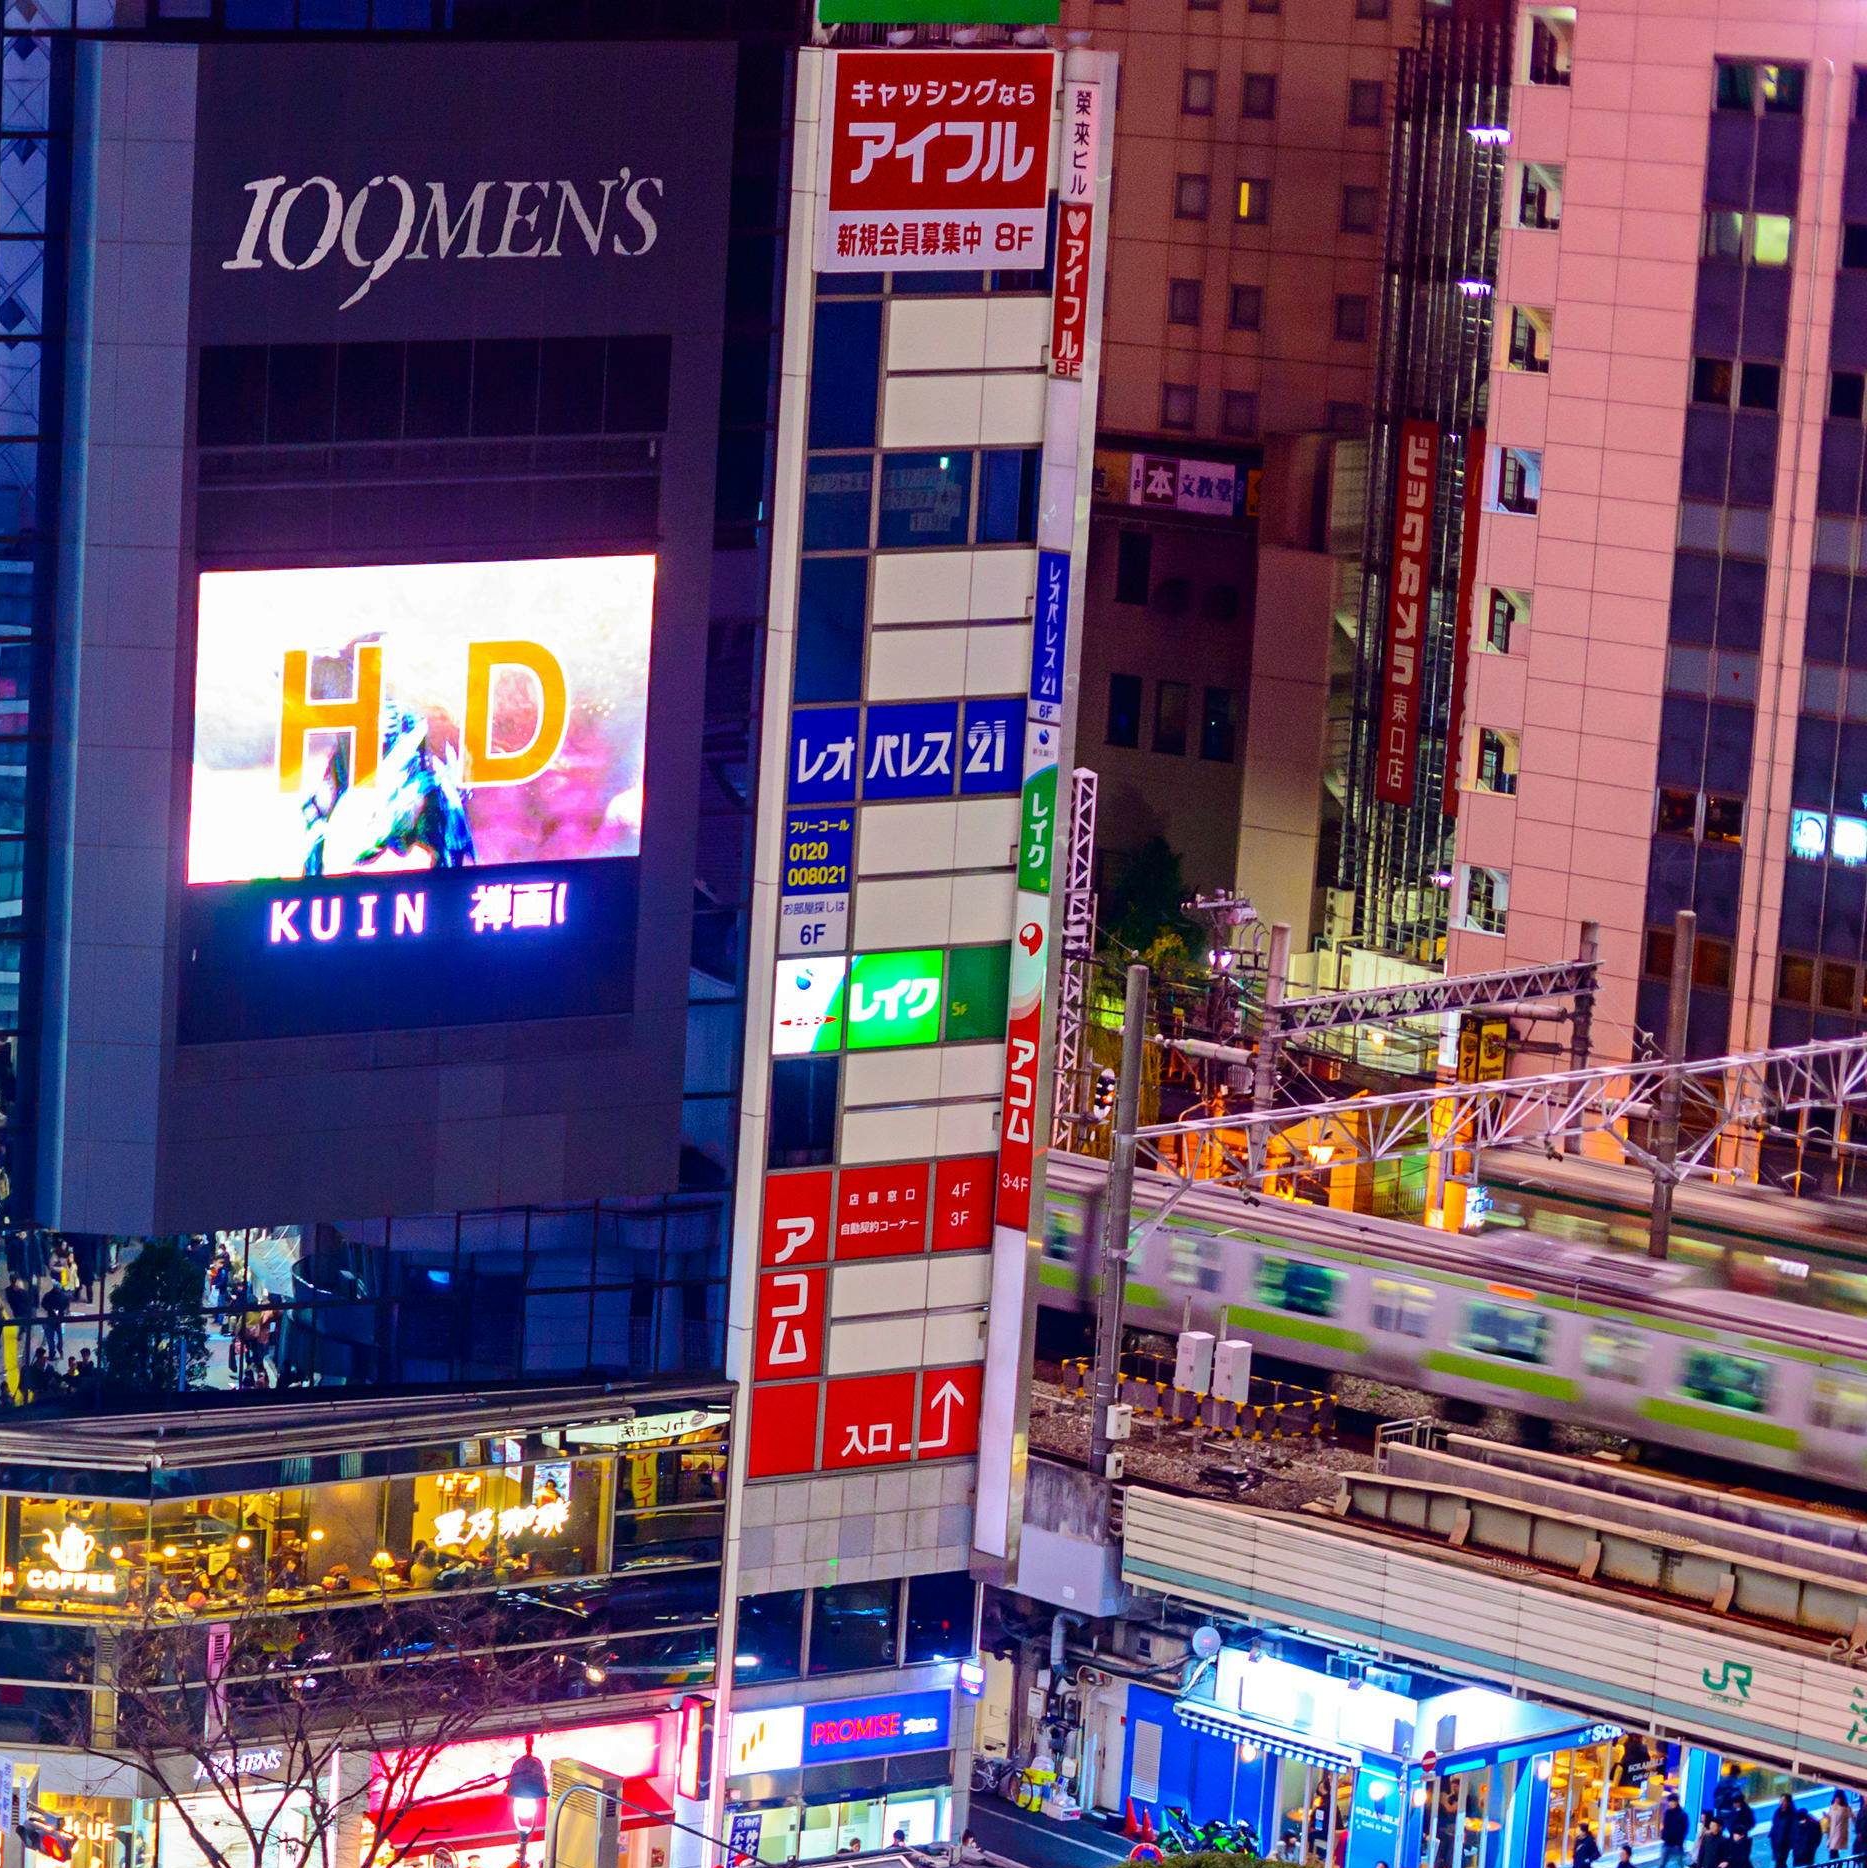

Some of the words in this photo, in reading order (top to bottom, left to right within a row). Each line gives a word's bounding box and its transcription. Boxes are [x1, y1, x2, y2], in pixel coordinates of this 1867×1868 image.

[851, 77, 1035, 107] キャッシングなら
[847, 121, 1035, 184] アイフル
[837, 222, 981, 257] 新規会員募集中
[995, 222, 1033, 252] 8F
[1057, 240, 1086, 360] アイフル
[1055, 361, 1081, 377] 8F
[1392, 436, 1430, 686] ビックカメラ
[1040, 560, 1066, 695] レオパレス21
[279, 644, 383, 792] H
[462, 639, 567, 786] D
[1038, 704, 1054, 718] 6F
[797, 720, 1005, 784] レオパレス21
[1386, 694, 1409, 789] 東口店
[789, 819, 850, 834] フリーコール
[1027, 793, 1049, 869] レイク
[789, 842, 828, 861] 0120
[787, 866, 847, 886] 008021
[269, 891, 427, 943] KUIN
[783, 899, 846, 915] お部屋探しは
[800, 924, 826, 946] 6F
[849, 977, 940, 1022] レイク
[1008, 1038, 1036, 1144] アコム
[848, 1187, 916, 1207] 店頭窓口
[951, 1181, 972, 1200] 4F
[840, 1216, 920, 1236] 自動契約コーナー
[949, 1209, 970, 1228] 3F
[768, 1215, 815, 1366] アコム
[842, 1423, 894, 1457] 入口
[27, 1569, 116, 1593] COFFEE
[1703, 1660, 1753, 1698] JR
[811, 1713, 901, 1746] PROMISE
